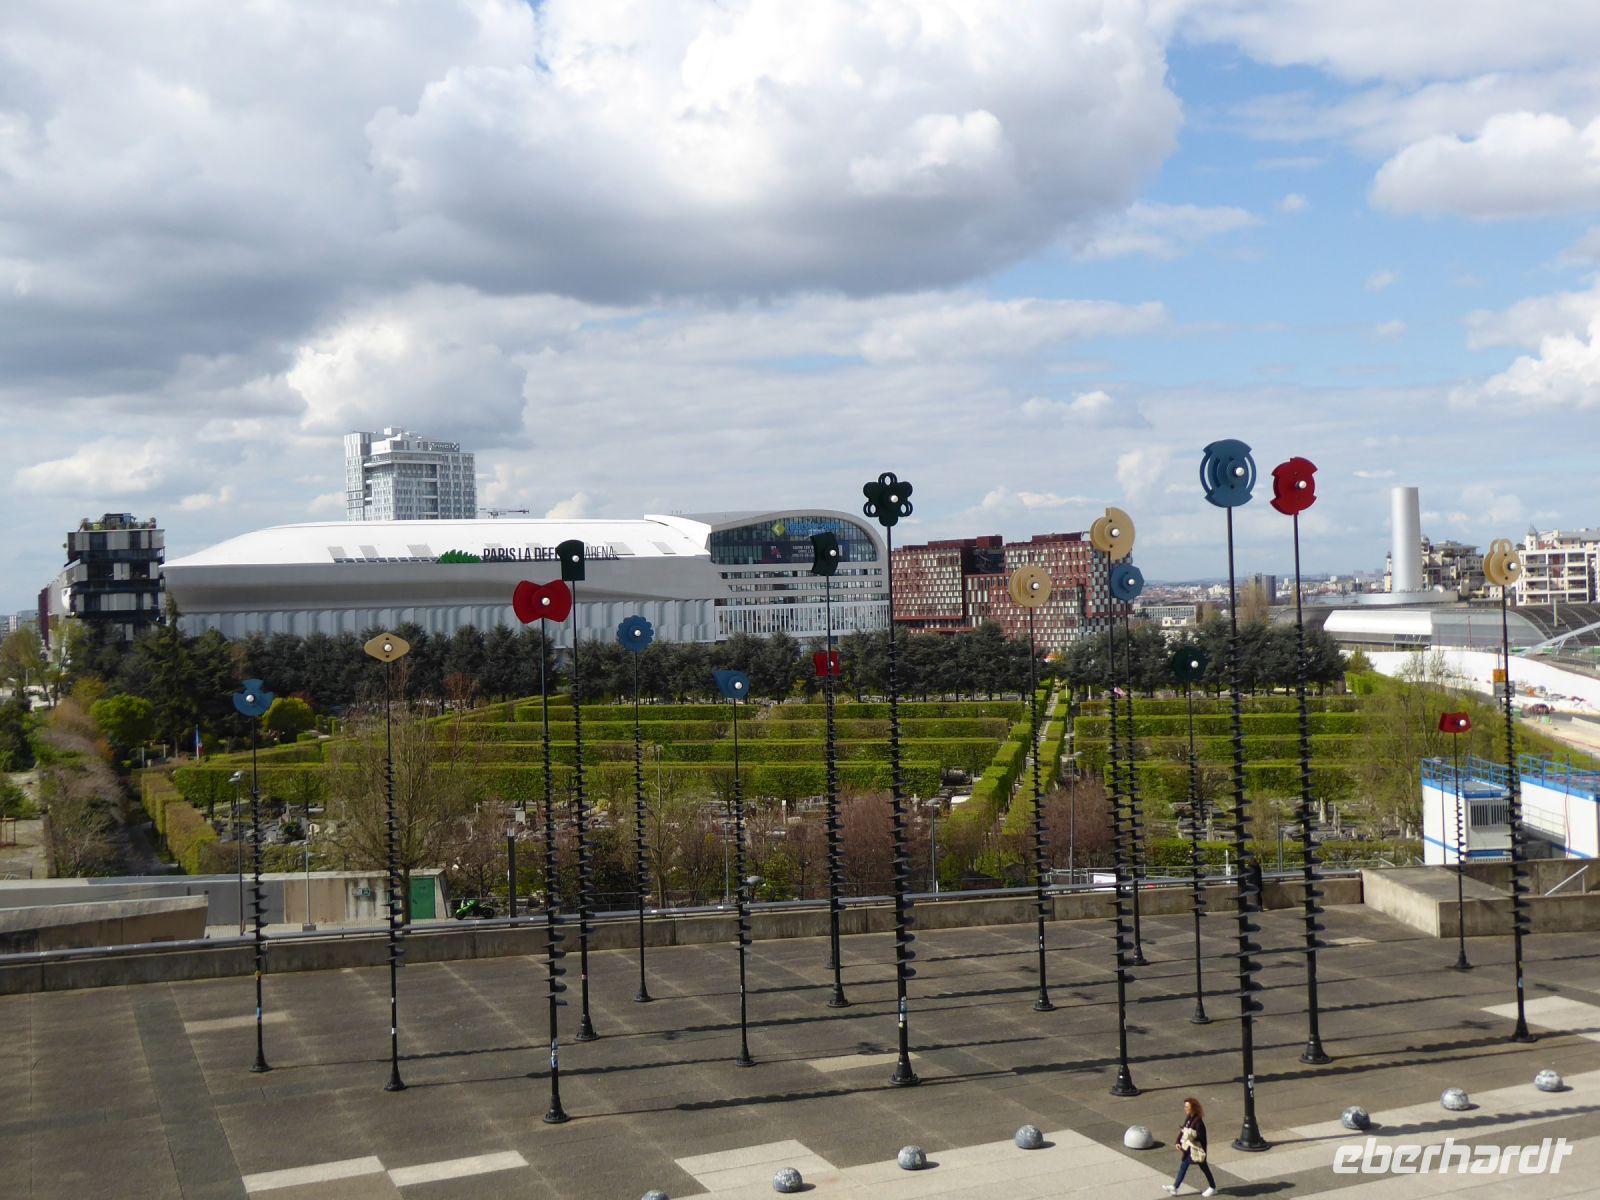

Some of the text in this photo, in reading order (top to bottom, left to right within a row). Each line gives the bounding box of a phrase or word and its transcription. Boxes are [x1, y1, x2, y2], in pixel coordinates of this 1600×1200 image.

[483, 547, 516, 561] PARIS
[518, 547, 531, 560] LA
[585, 545, 615, 559] ARENA
